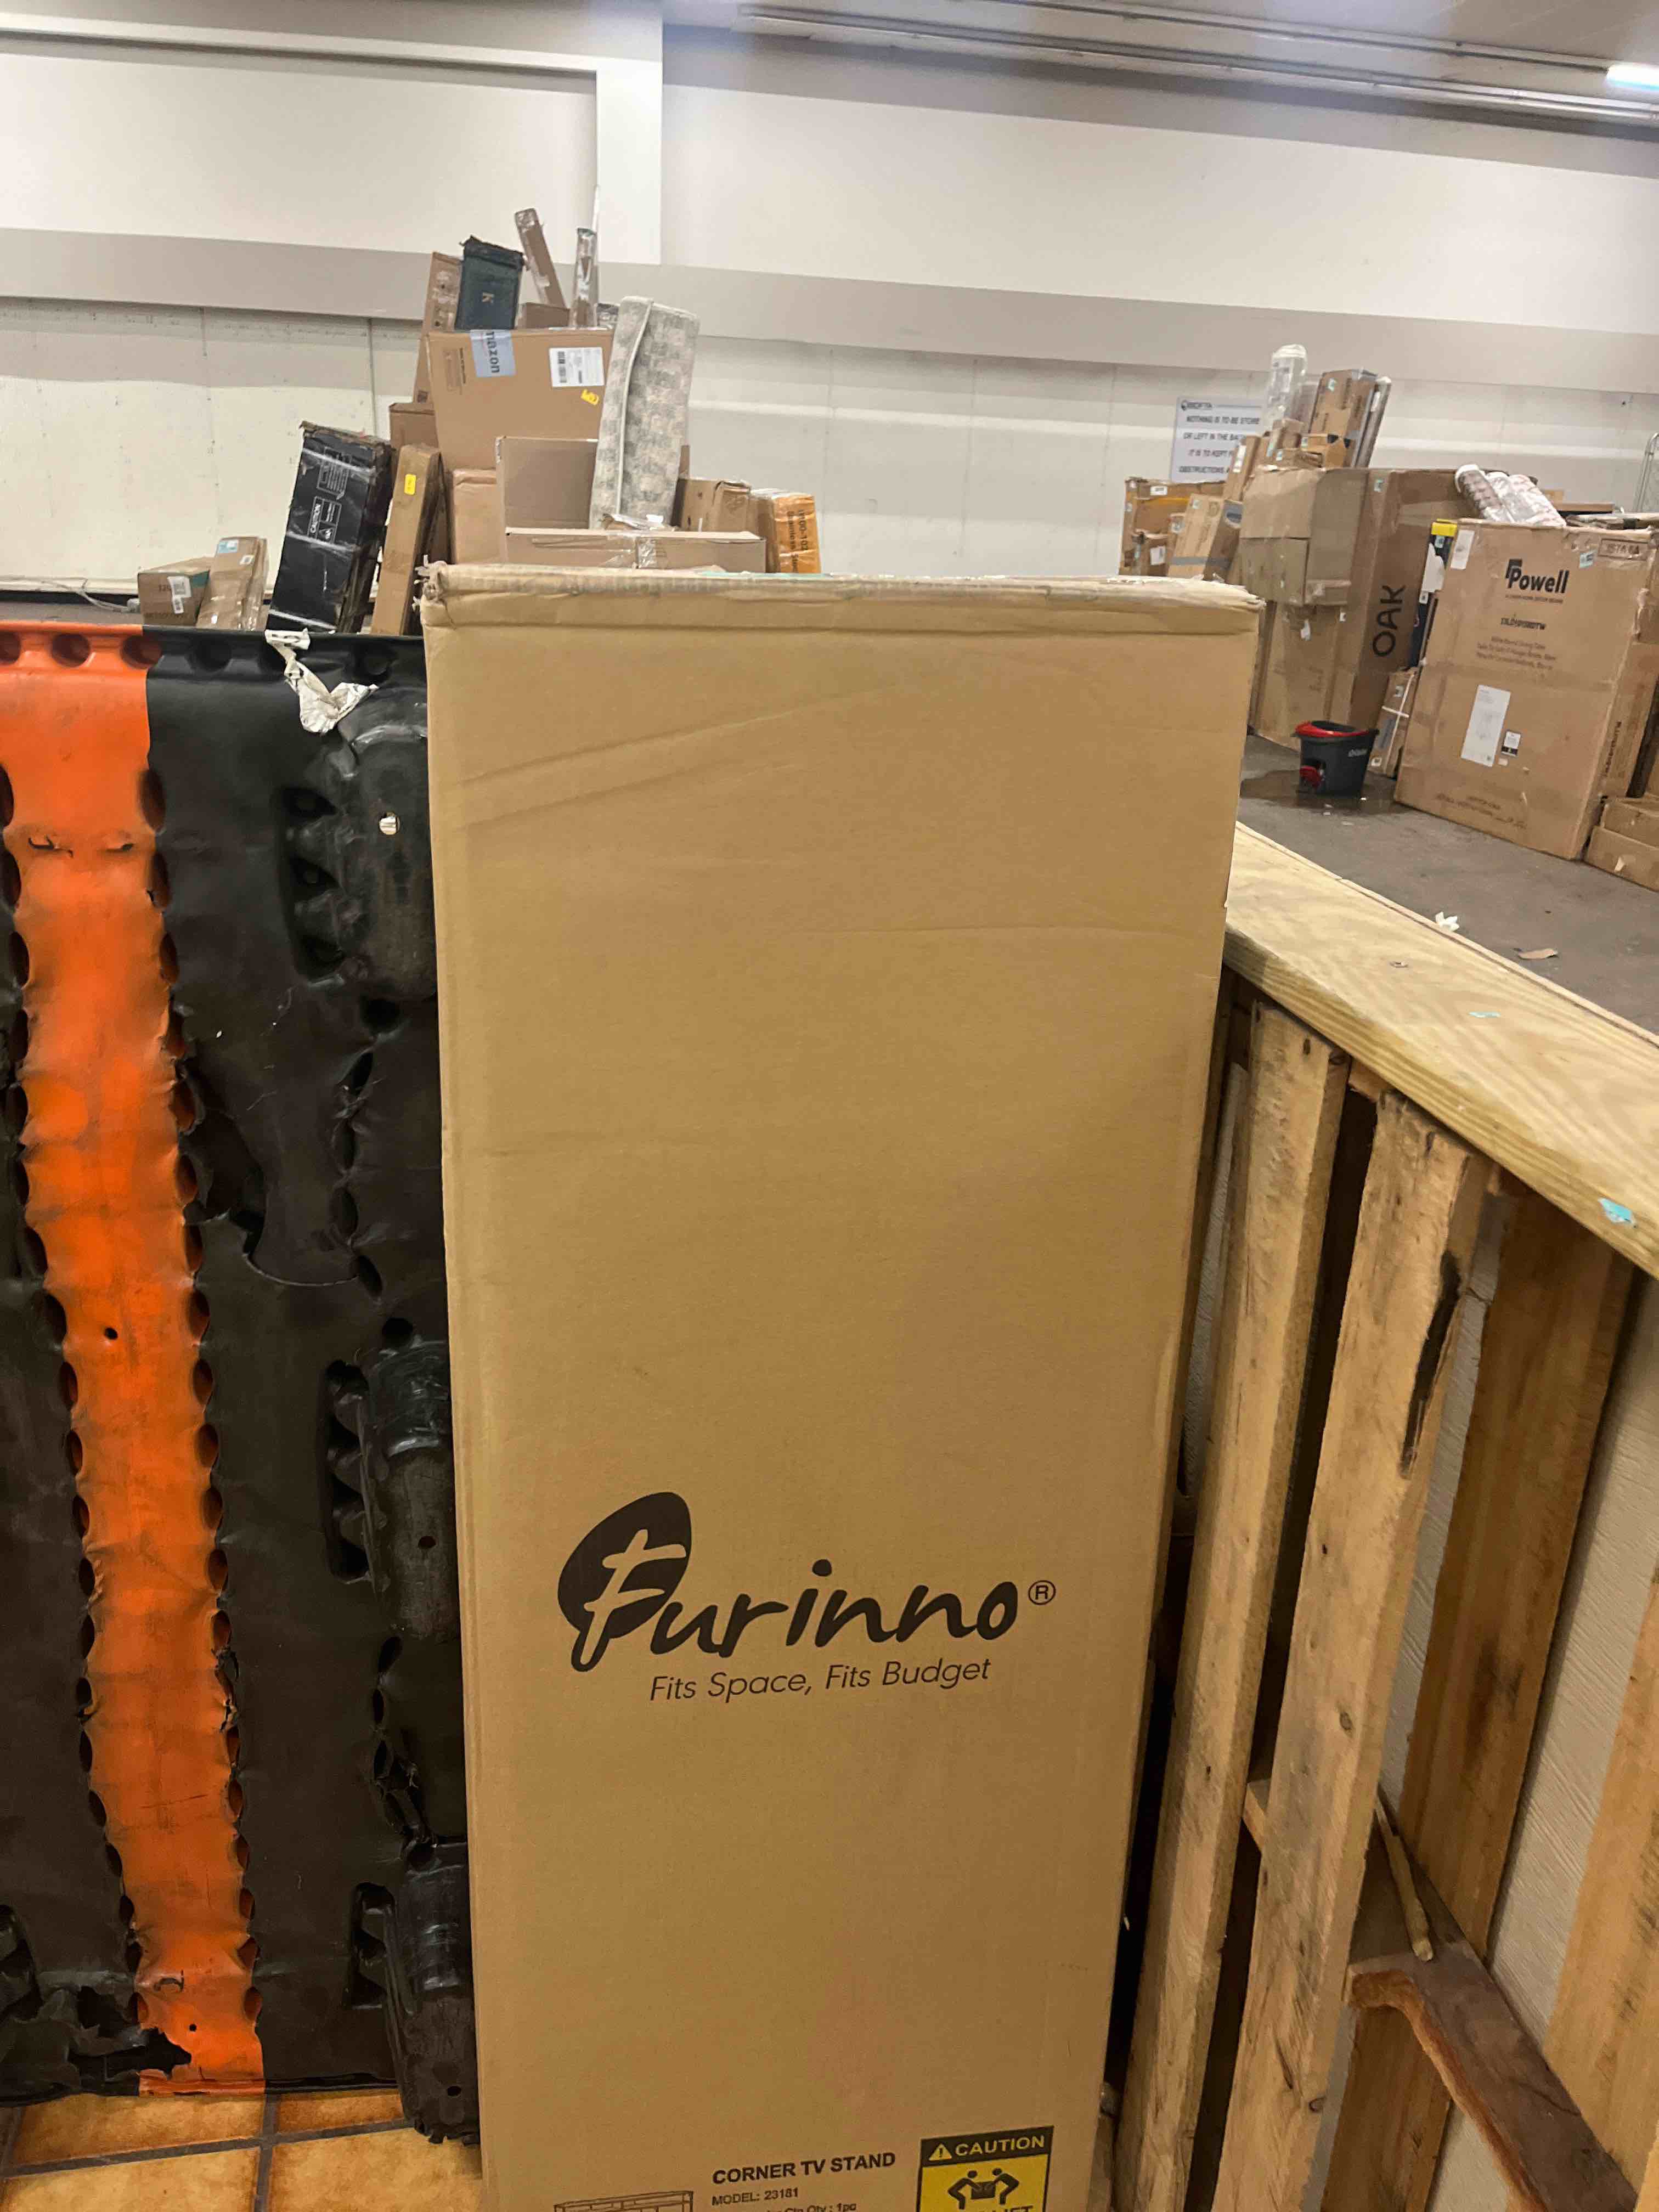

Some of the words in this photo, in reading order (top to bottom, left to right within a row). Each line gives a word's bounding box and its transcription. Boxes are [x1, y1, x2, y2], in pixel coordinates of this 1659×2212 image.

[1505, 559, 1570, 594] Powell
[1372, 585, 1406, 657] OAK
[650, 1675, 696, 1701] Fits
[707, 1669, 812, 1703] Space,
[825, 1664, 871, 1690] Fits
[882, 1658, 991, 1689] Budget
[955, 2135, 1045, 2156] CAUTION
[712, 2163, 796, 2185] CORNER
[800, 2159, 826, 2176] TV
[830, 2152, 896, 2172] STAND
[712, 2192, 760, 2206] MODEL:
[764, 2187, 799, 2201] 23181
